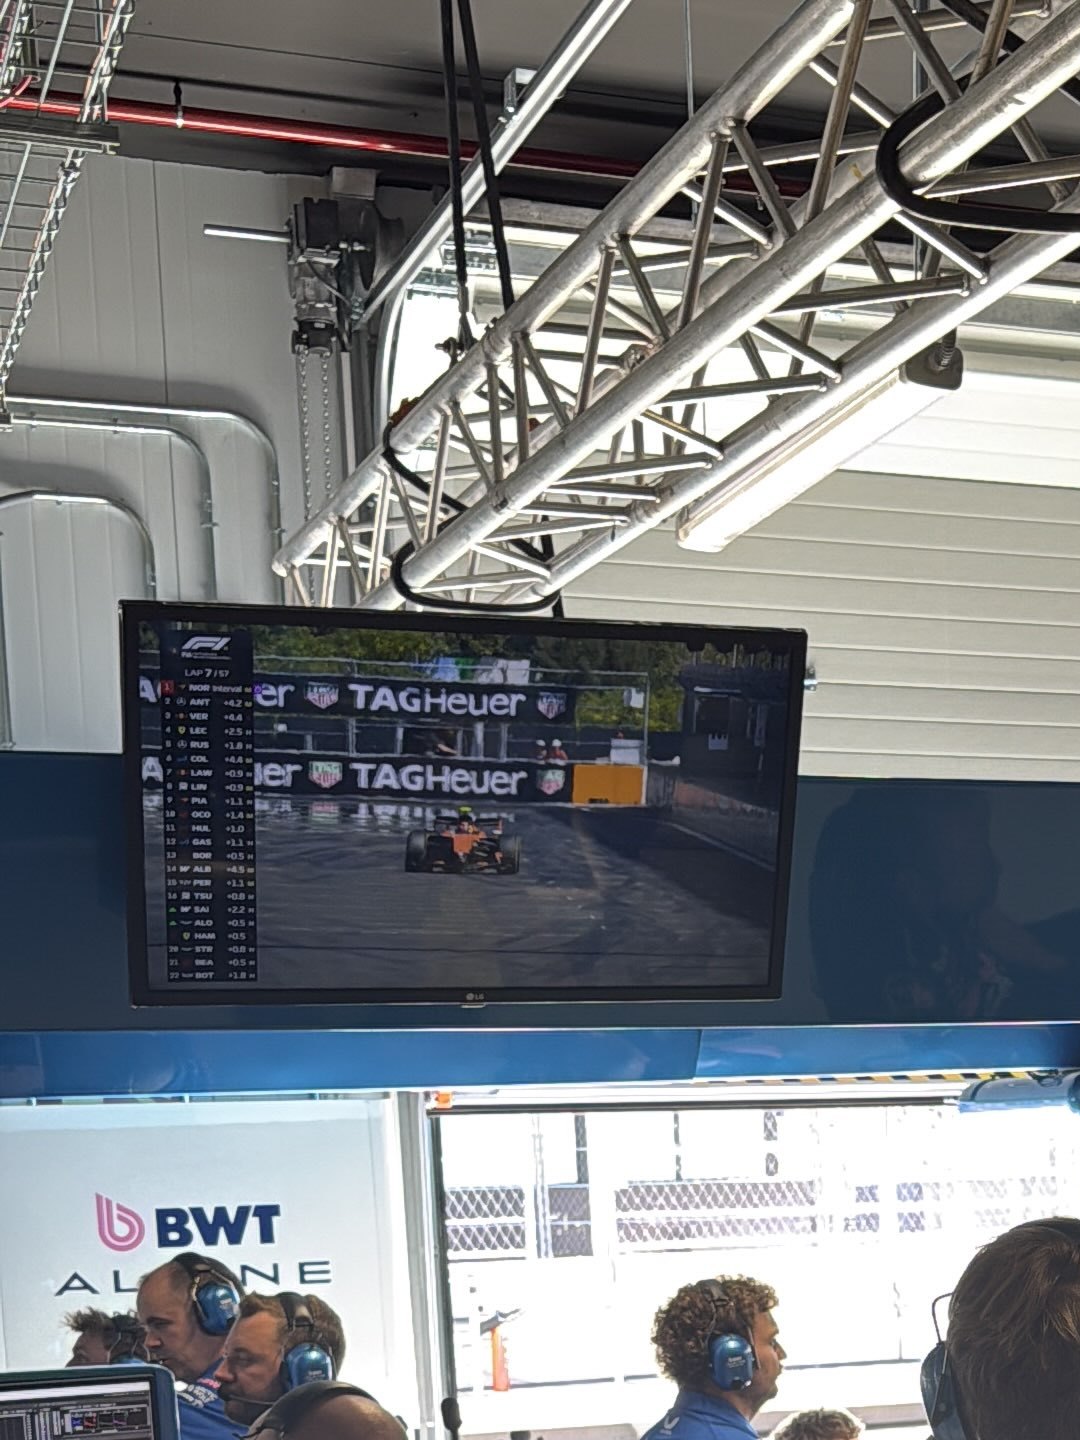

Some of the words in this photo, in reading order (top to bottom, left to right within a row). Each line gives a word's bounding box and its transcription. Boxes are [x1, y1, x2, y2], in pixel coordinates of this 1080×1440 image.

[185, 669, 203, 677] LAP
[189, 684, 210, 692] NOR
[213, 685, 242, 693] Interval
[190, 698, 210, 706] ANT
[189, 712, 208, 720] VER
[190, 755, 208, 763] COL
[156, 1204, 281, 1248] BWT
[55, 1260, 332, 1297] ALNE
